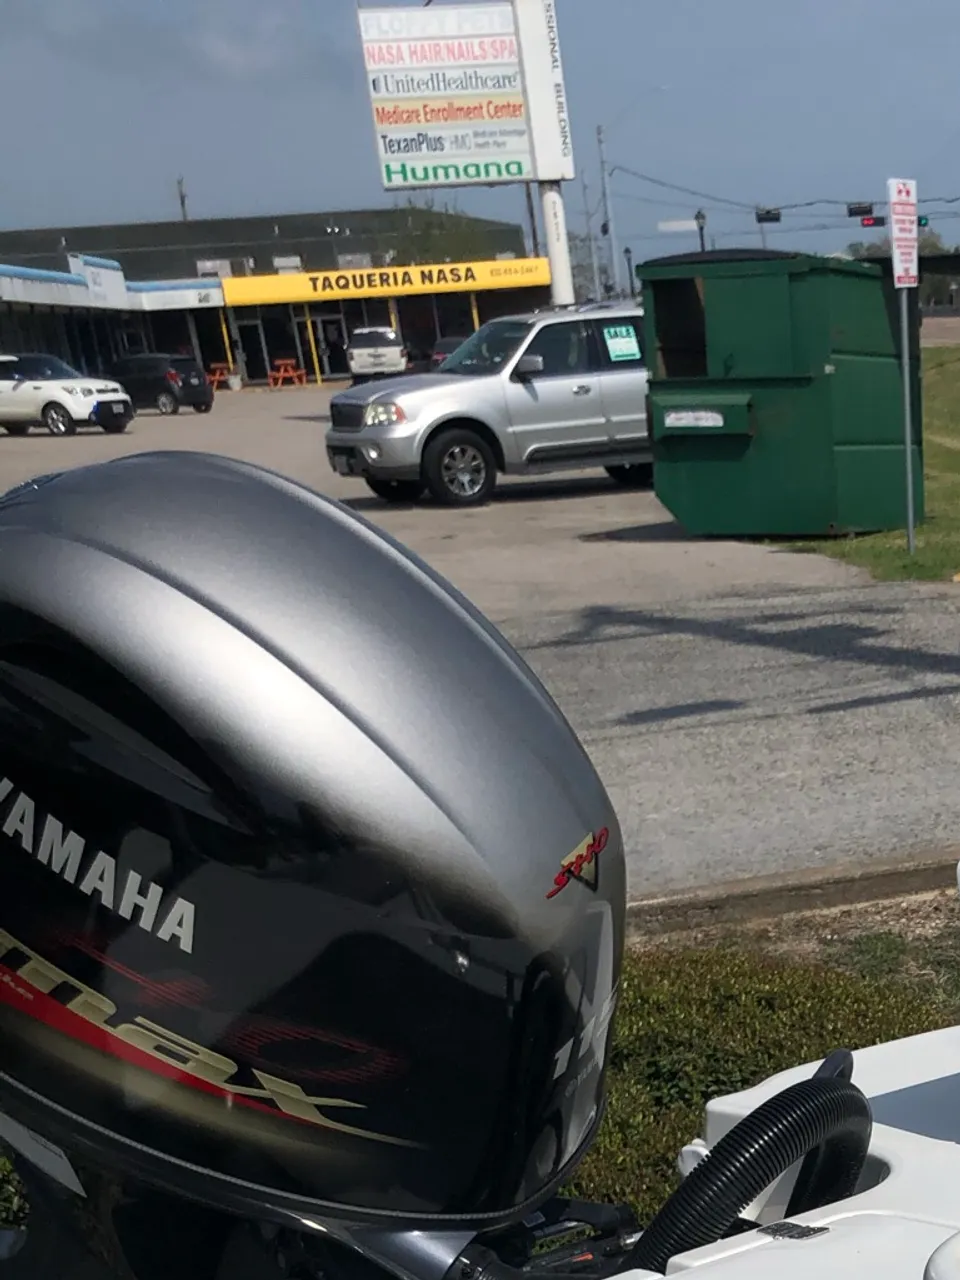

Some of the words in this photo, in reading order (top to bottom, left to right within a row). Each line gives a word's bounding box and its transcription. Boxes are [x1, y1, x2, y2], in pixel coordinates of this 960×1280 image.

[365, 43, 404, 66] NASA
[383, 70, 518, 94] UnitedHealthcare
[375, 105, 421, 125] Medicare
[423, 101, 485, 123] Enrollment
[486, 100, 524, 120] Center
[381, 132, 446, 154] TexanPlus
[384, 161, 524, 183] Humana
[309, 270, 413, 293] TAQUERIA
[420, 267, 477, 285] NASA
